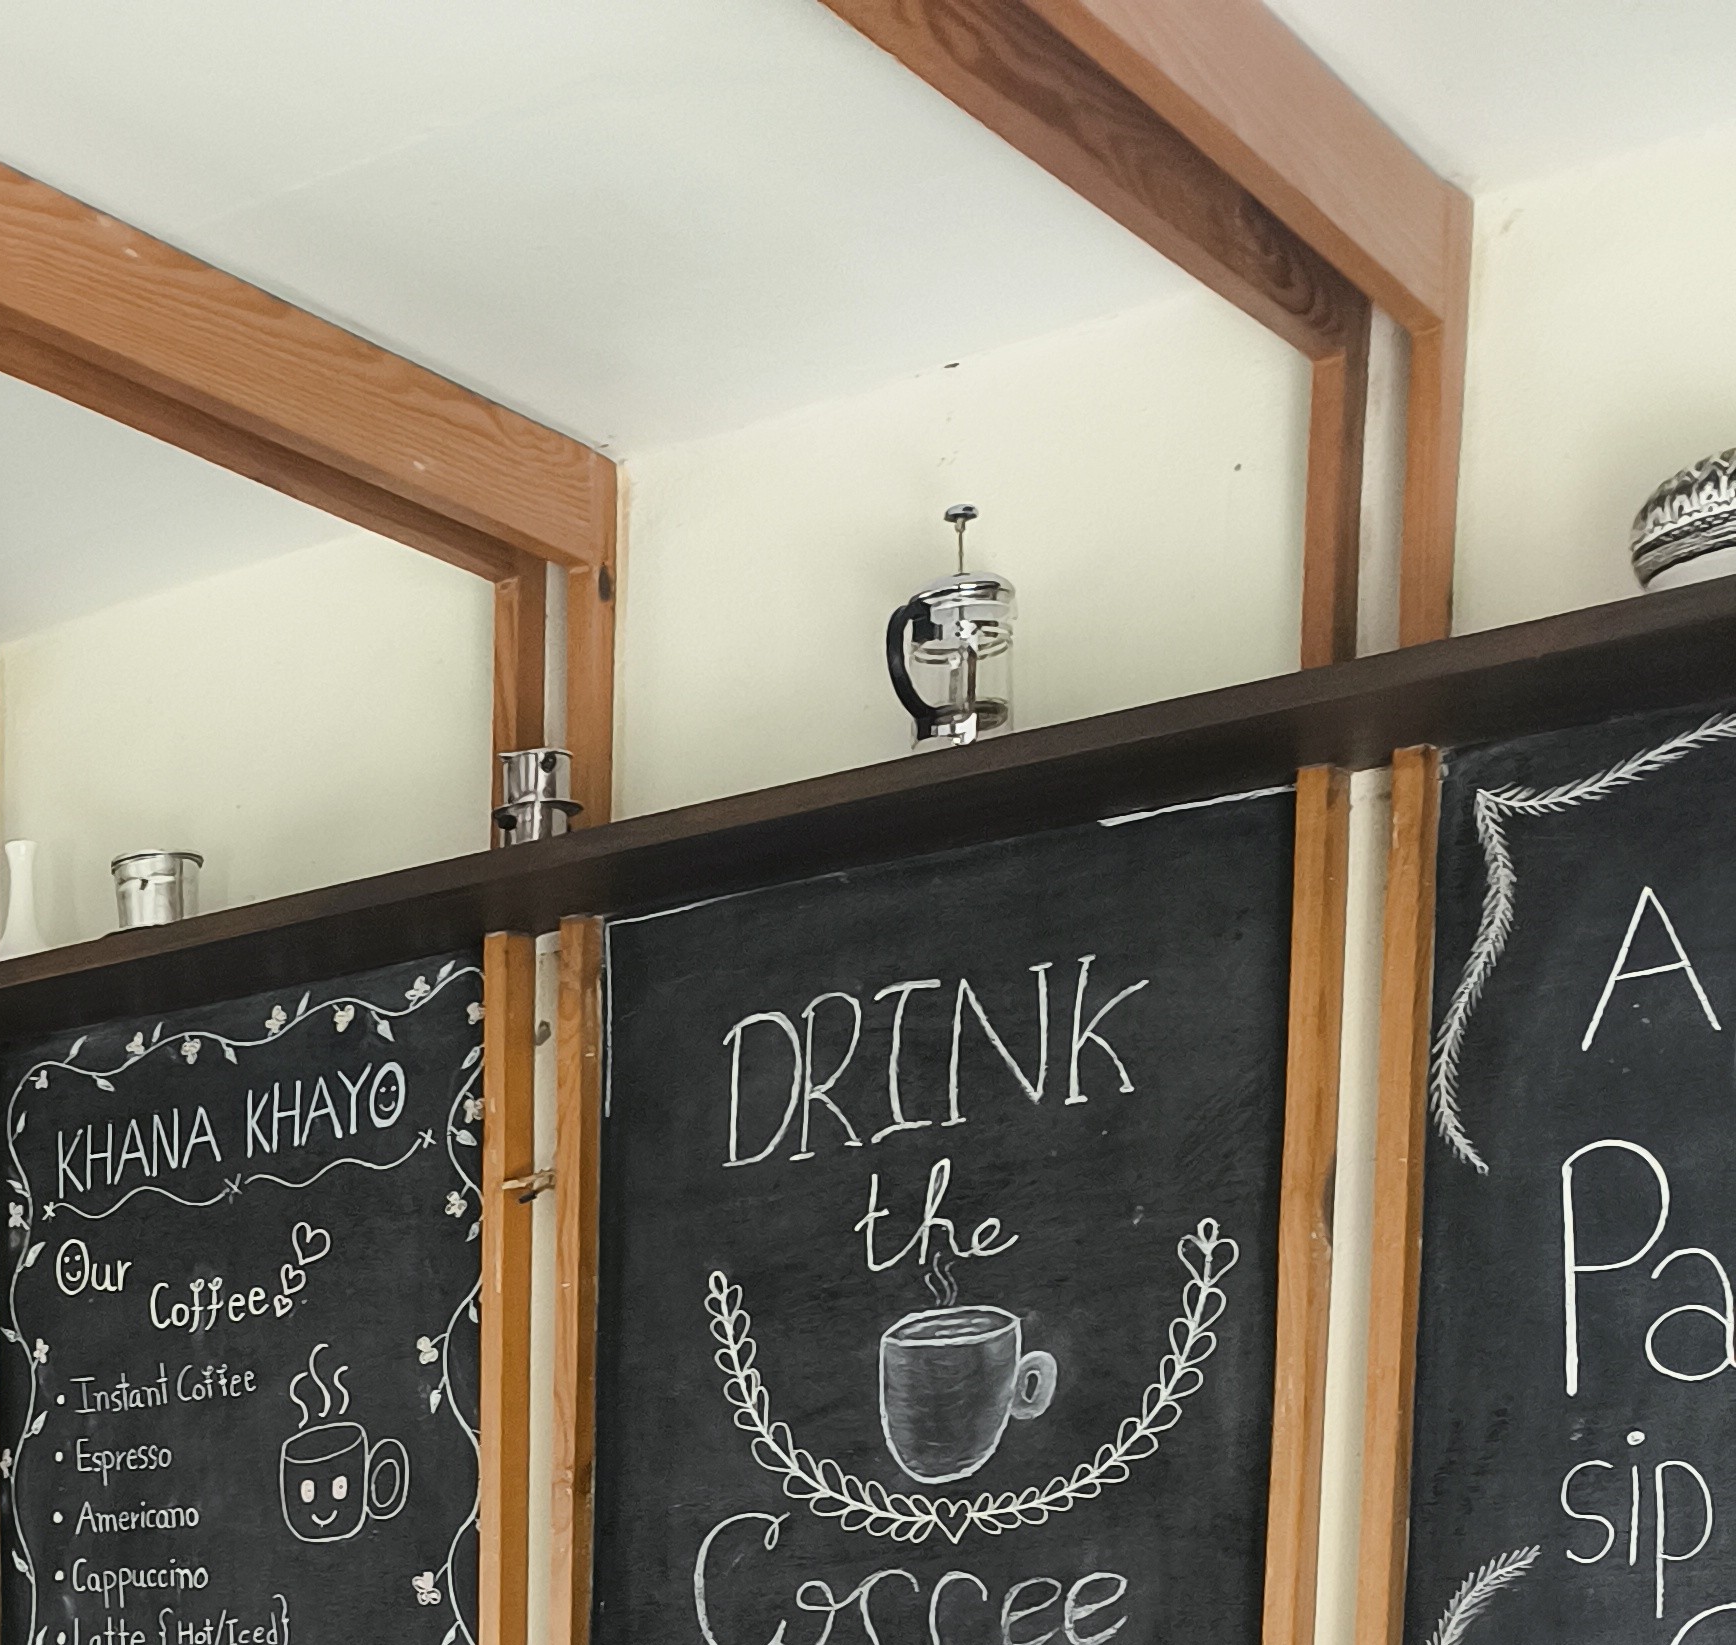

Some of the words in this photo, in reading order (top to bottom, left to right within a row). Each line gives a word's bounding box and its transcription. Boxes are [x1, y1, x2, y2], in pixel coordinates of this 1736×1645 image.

[1581, 886, 1722, 1051] A
[722, 954, 1149, 1168] DRINK
[57, 1106, 221, 1198] KHANA
[246, 1062, 405, 1158] KHAYO
[855, 1158, 1019, 1271] the
[56, 1239, 132, 1295] Our
[150, 1277, 268, 1331] Coffee
[70, 1363, 167, 1414] Instant
[177, 1364, 256, 1402] Coffee
[75, 1439, 172, 1485] Espresso
[75, 1501, 199, 1535] Americano
[1561, 1430, 1714, 1618] sip
[73, 1558, 209, 1608] Cappuccino
